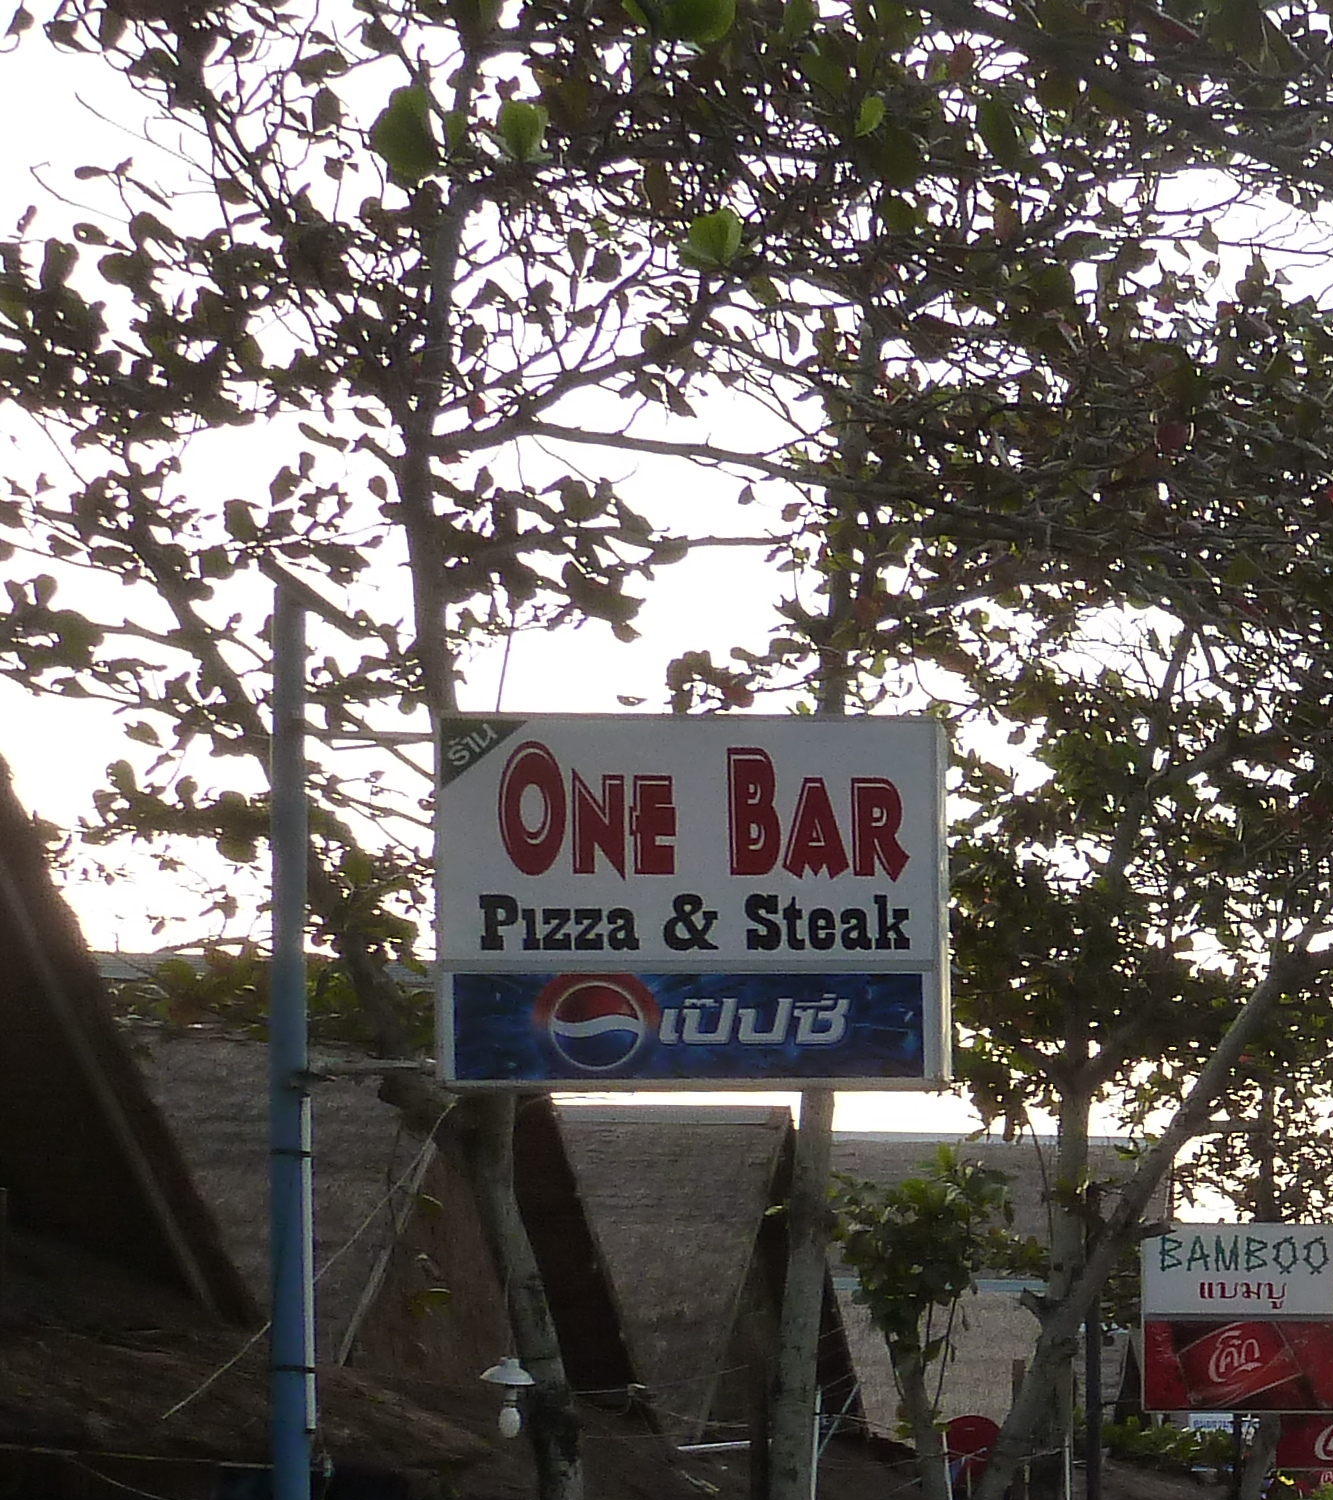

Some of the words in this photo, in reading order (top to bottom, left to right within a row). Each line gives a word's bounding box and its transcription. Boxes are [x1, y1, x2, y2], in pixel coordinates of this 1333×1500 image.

[446, 723, 498, 766] ร้าน
[479, 894, 639, 952] Pizza
[663, 893, 719, 951] &
[745, 893, 910, 952] Steak
[1158, 1235, 1330, 1275] BAMBOO
[1198, 1281, 1287, 1310] แบมบู
